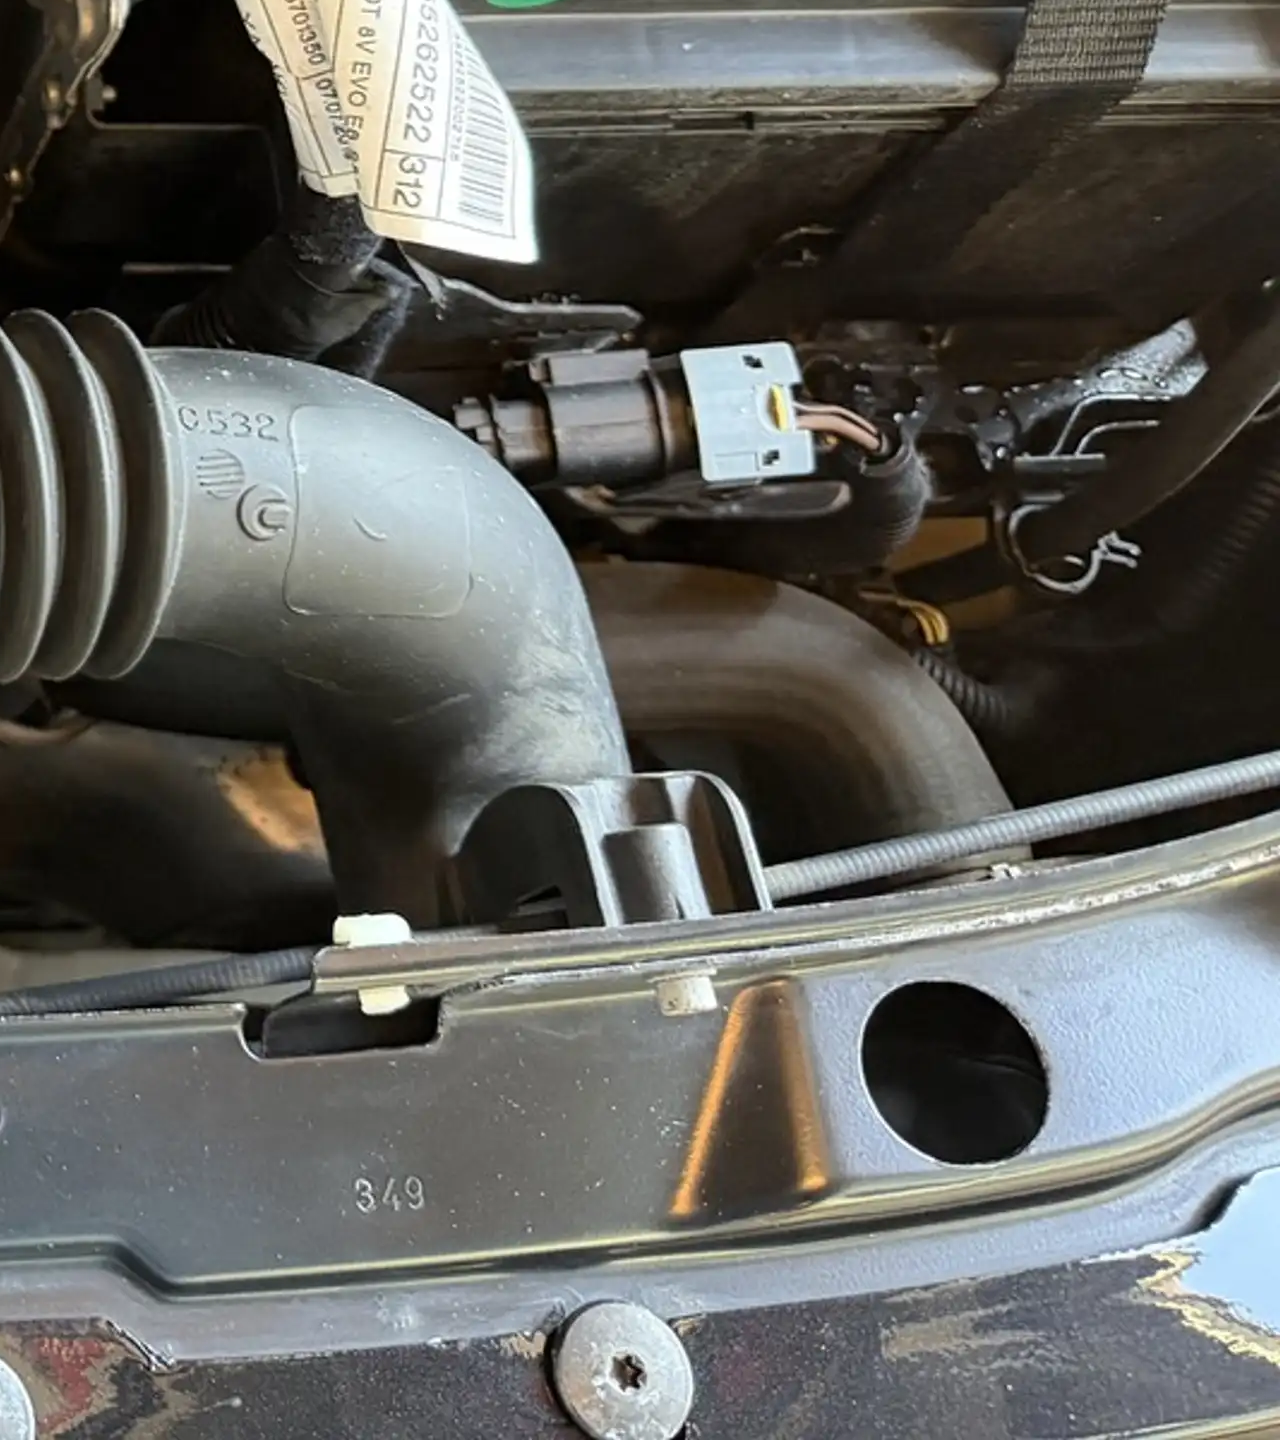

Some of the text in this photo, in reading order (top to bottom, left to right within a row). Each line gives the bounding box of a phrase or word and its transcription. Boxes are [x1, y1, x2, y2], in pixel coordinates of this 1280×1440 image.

[346, 62, 373, 111] EVO
[392, 155, 428, 209] 312
[354, 1176, 426, 1213] 349
